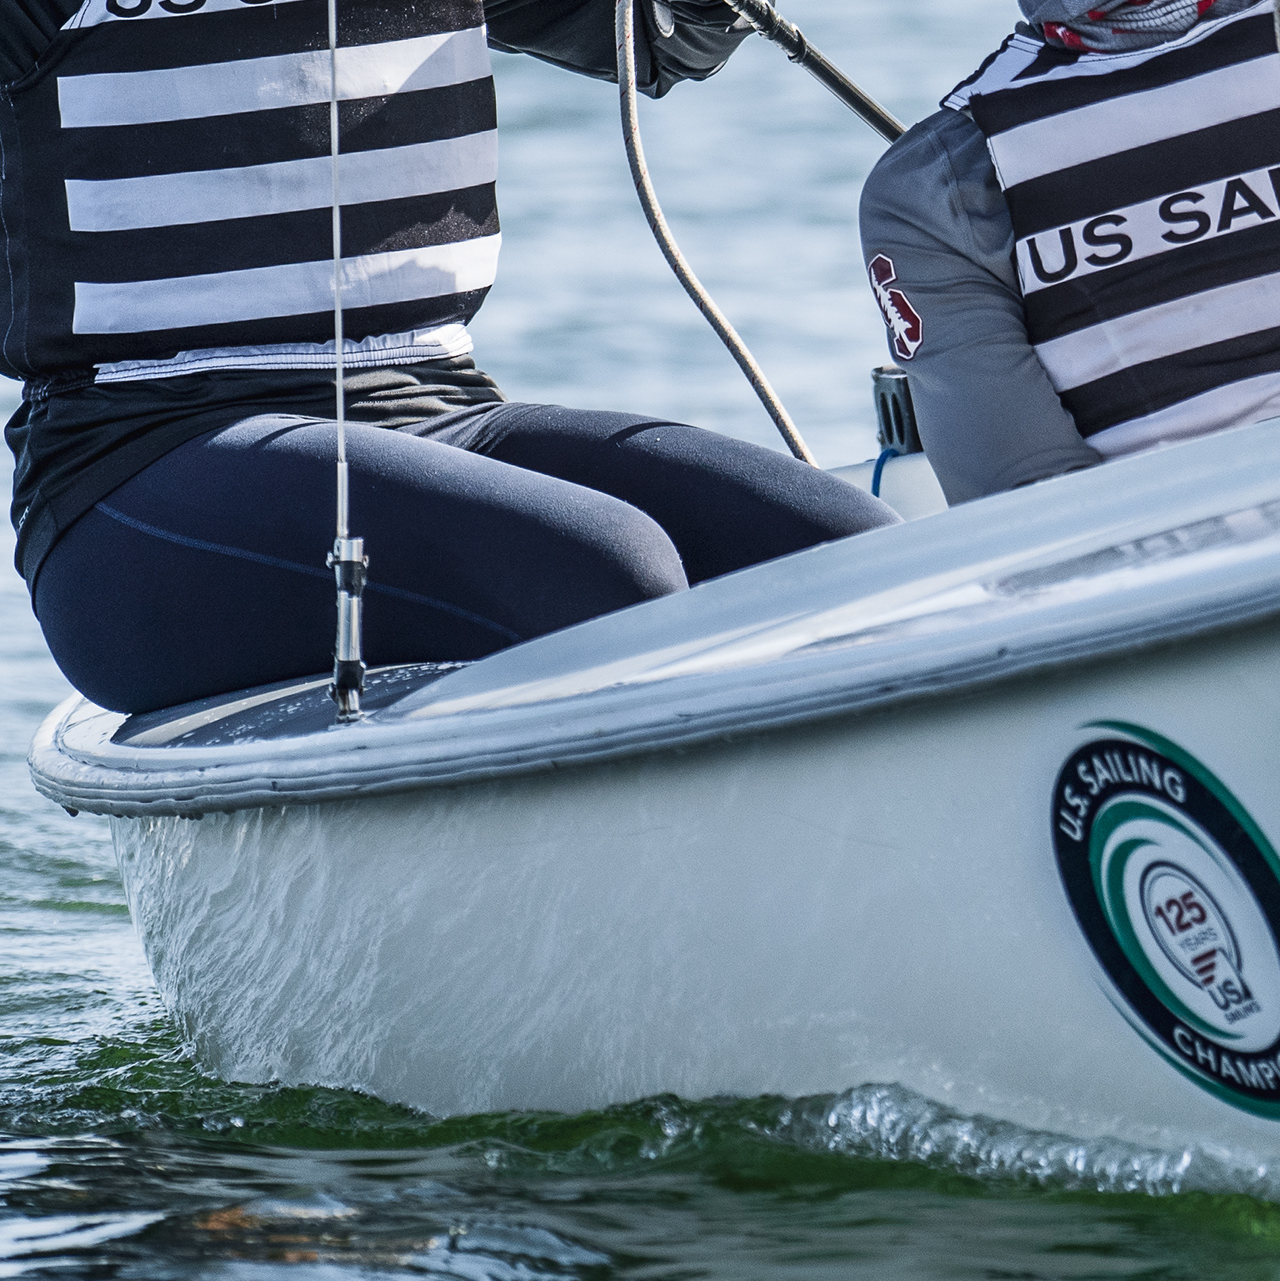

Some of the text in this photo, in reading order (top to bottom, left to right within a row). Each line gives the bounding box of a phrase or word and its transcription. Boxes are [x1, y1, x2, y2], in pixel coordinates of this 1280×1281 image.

[1026, 214, 1133, 284] US
[1059, 750, 1186, 842] U.S. SAILING
[1154, 891, 1207, 936] 125
[1207, 978, 1244, 1012] US
